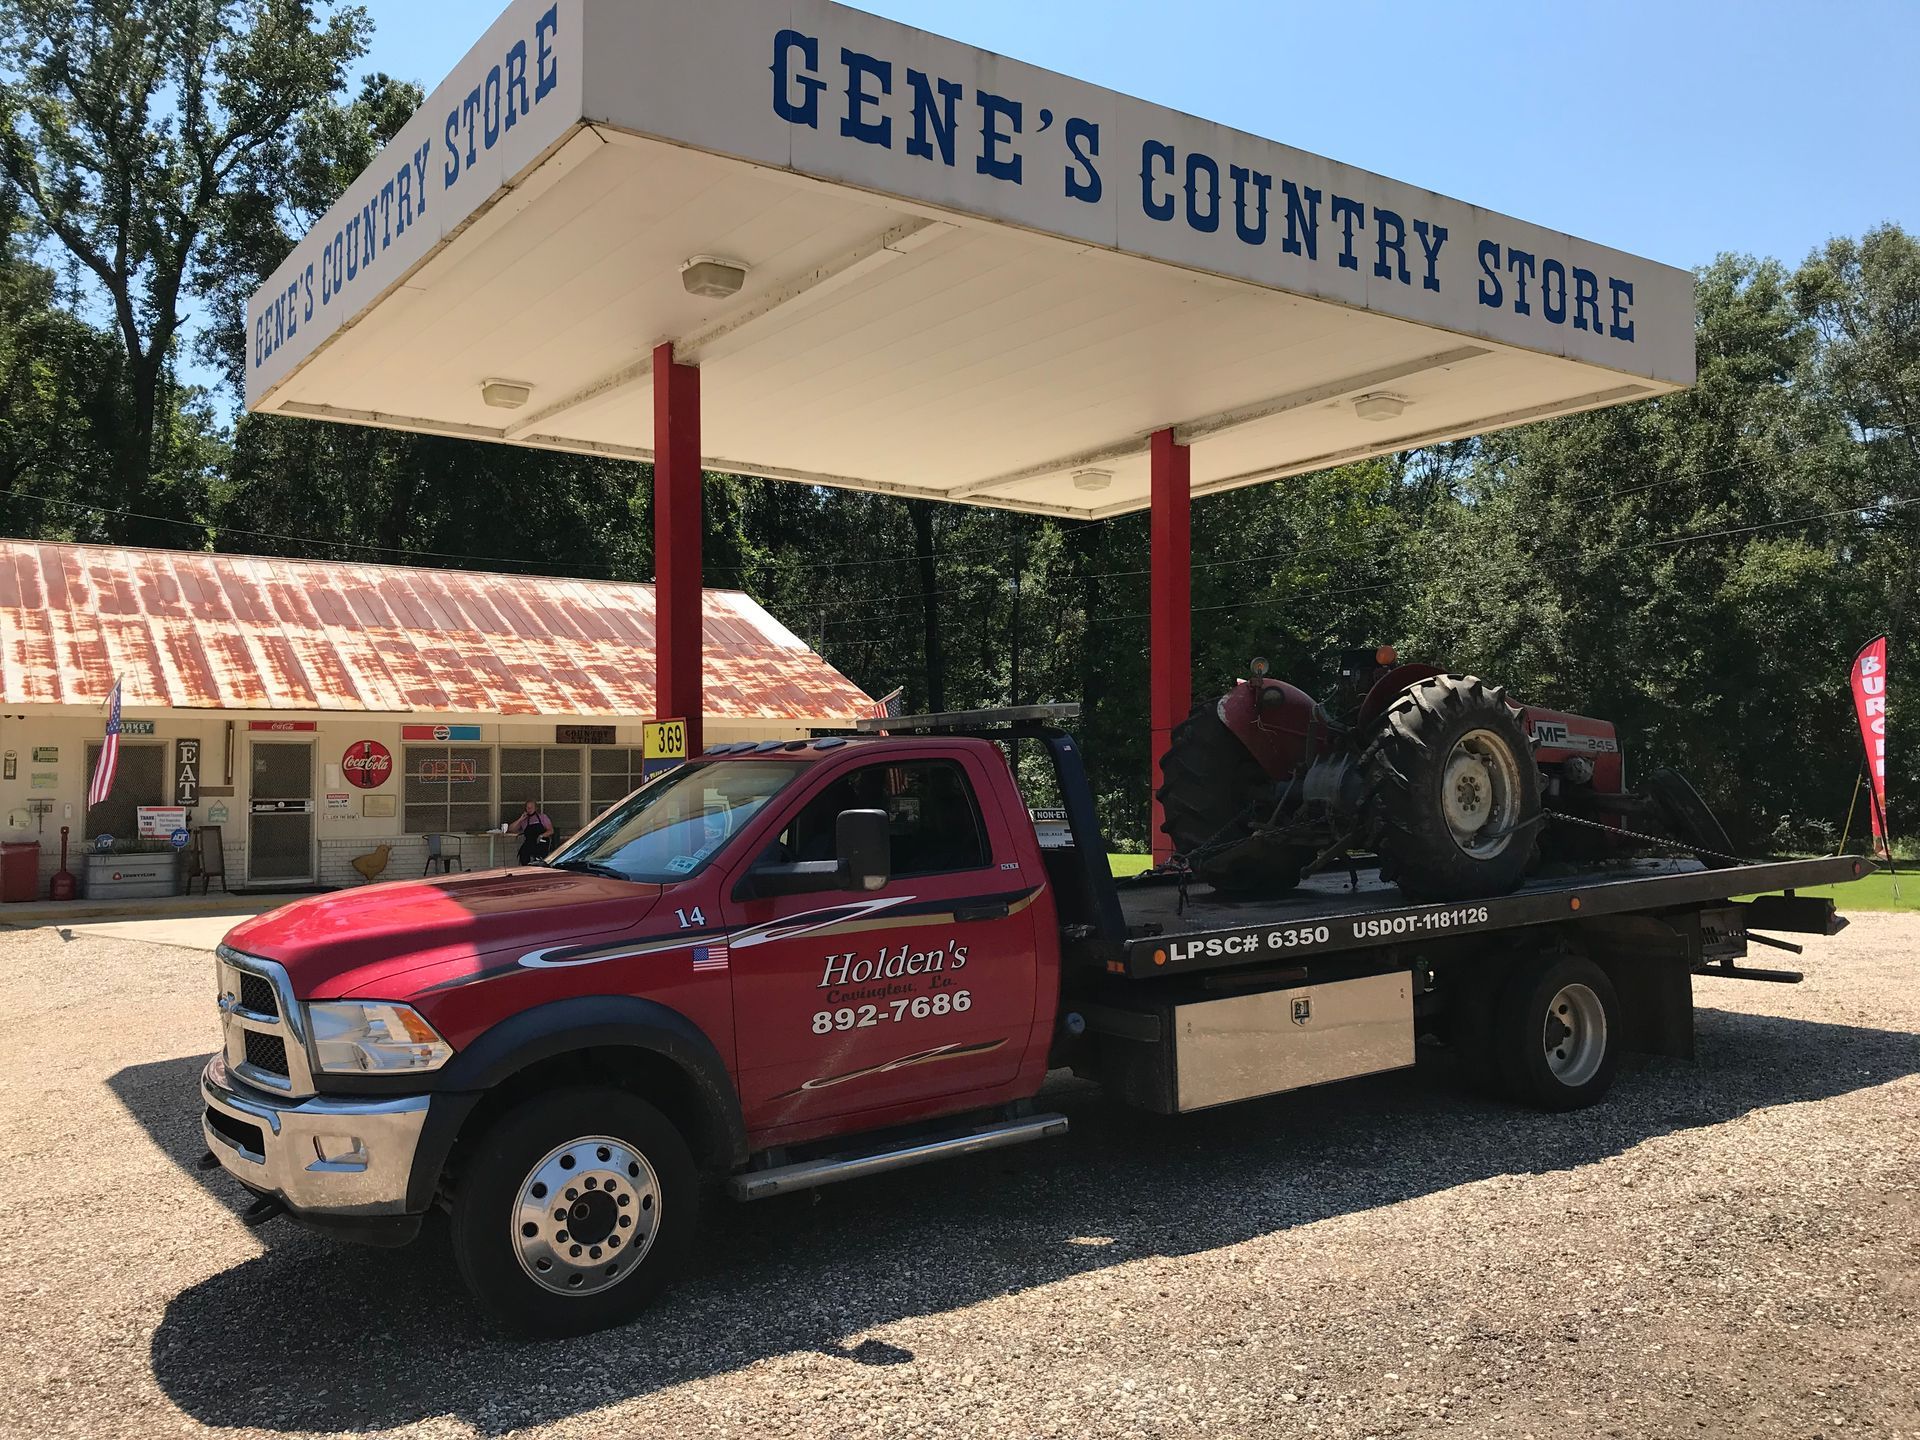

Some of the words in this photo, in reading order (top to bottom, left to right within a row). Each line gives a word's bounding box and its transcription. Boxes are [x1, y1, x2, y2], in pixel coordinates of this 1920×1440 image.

[254, 261, 314, 369] GENE'S
[322, 137, 431, 306] COUNTRY
[444, 2, 558, 191] STORE
[768, 28, 1103, 204] GENE'S
[1138, 138, 1449, 293] COUNTRY
[1477, 239, 1636, 344] STORE
[1537, 726, 1567, 743] MF
[1588, 739, 1615, 751] 245
[179, 746, 197, 800] EAT
[343, 754, 391, 771] Coca-Cola
[422, 761, 474, 781] OPEN
[1037, 810, 1068, 819] NON-ET
[172, 833, 187, 841] ADT
[674, 905, 706, 929] 14
[1169, 933, 1260, 962] LPSC#
[1266, 925, 1331, 950] 6350
[1352, 905, 1489, 940] USDOT-1181126
[815, 938, 969, 989] Holden's
[811, 989, 973, 1036] 892-7686
